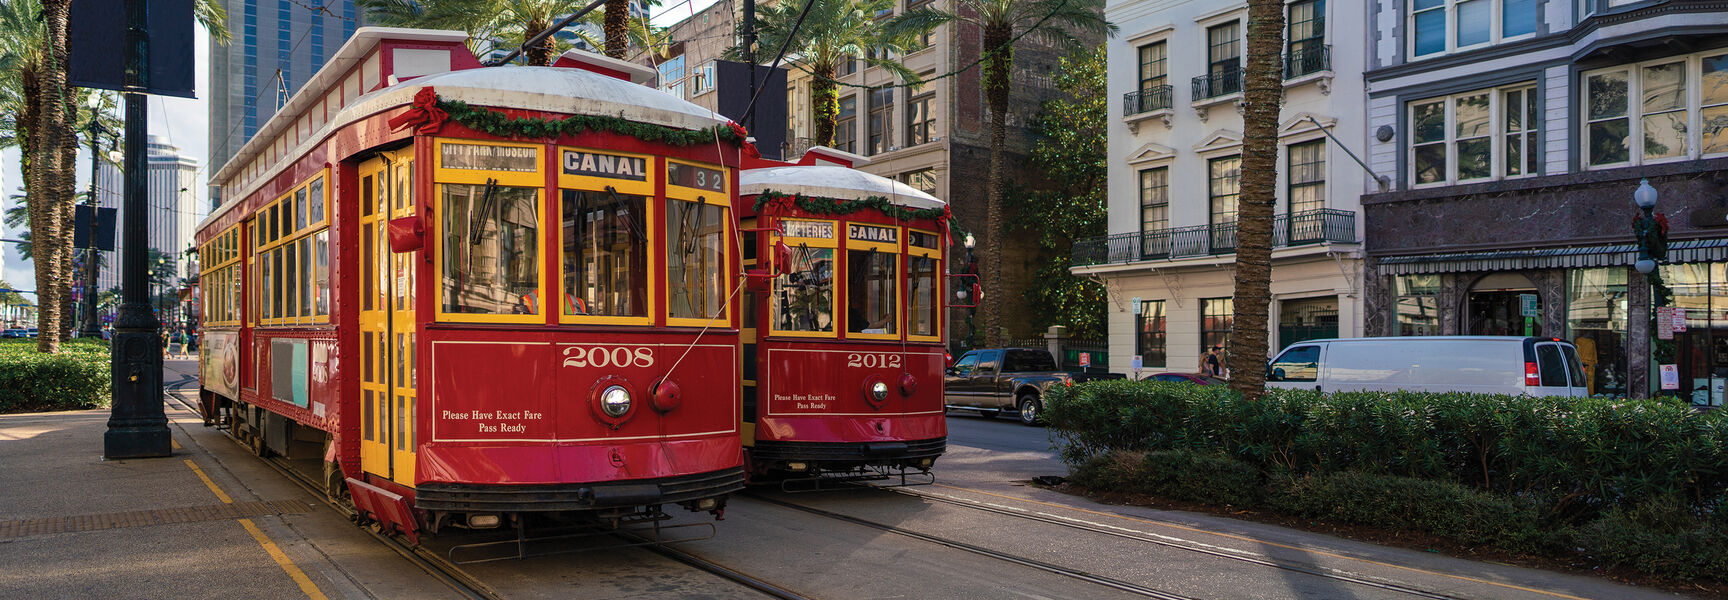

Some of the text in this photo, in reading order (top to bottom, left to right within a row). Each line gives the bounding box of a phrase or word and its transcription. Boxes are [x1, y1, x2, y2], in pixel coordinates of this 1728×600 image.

[564, 151, 646, 177] CANAL
[849, 225, 896, 242] CANAL
[563, 347, 654, 368] 2008
[847, 353, 901, 369] 2012
[442, 410, 542, 420] Please Have Exact Fare
[479, 423, 526, 433] Pass Ready
